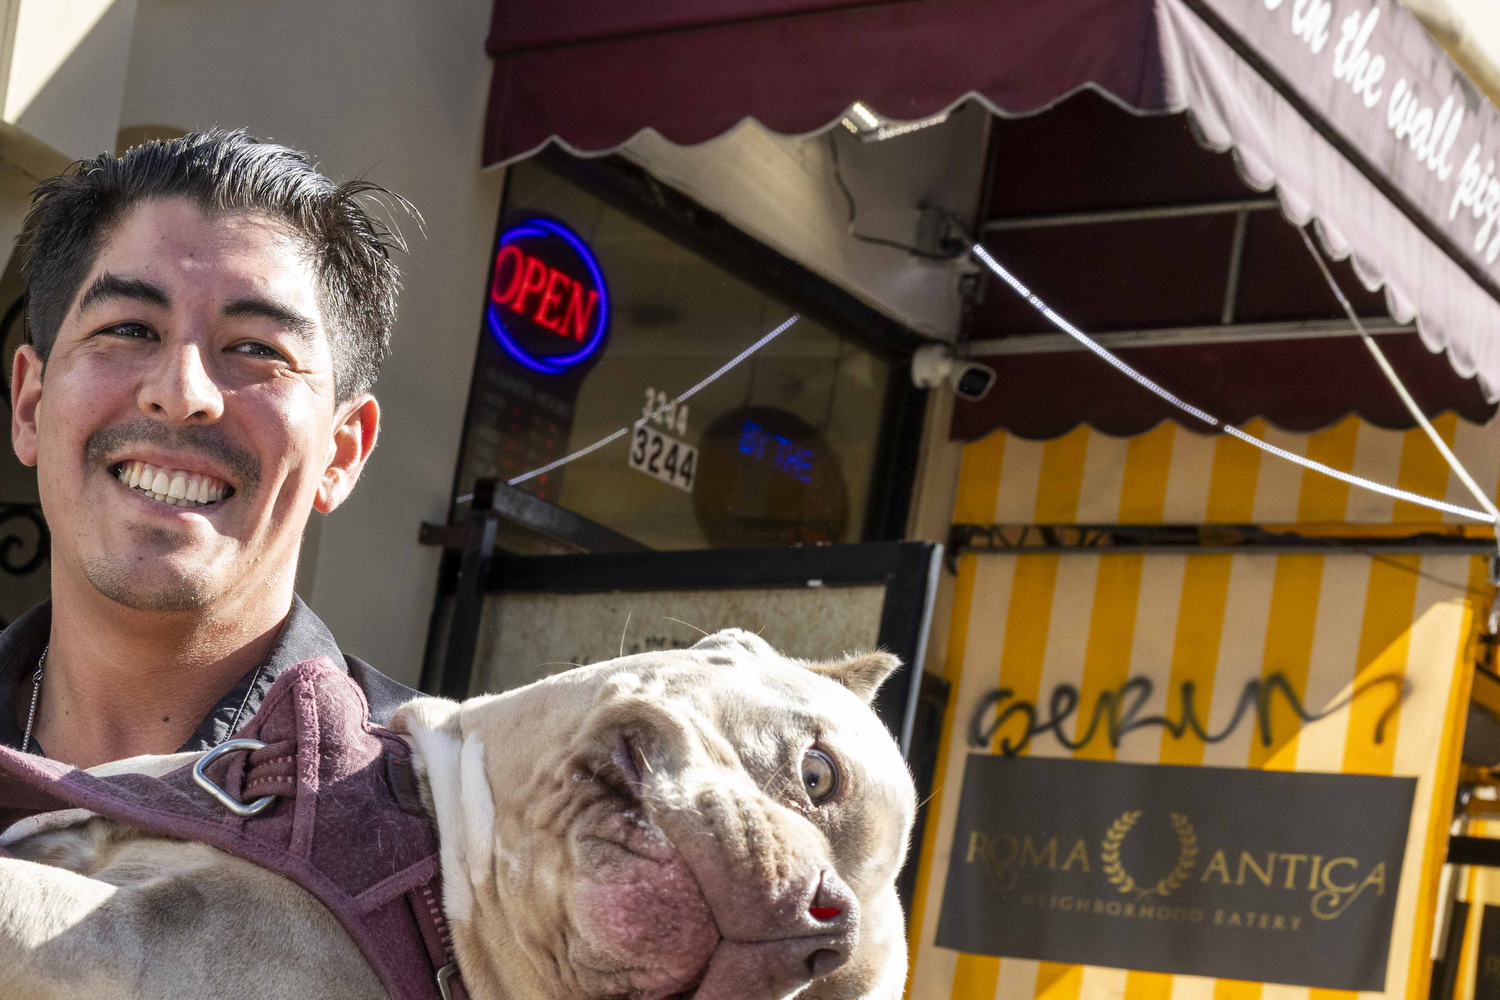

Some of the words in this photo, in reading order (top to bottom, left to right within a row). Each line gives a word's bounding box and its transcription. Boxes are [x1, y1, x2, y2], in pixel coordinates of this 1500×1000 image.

[1333, 7, 1385, 109] the
[1387, 78, 1463, 182] wall
[491, 246, 597, 342] OPEN
[642, 387, 690, 437] 3244
[633, 428, 695, 487] 3244
[966, 831, 1091, 890] ROMA
[1202, 849, 1386, 920] ANTICA
[1020, 893, 1202, 923] NEIGHBORHOOD
[1213, 908, 1304, 931] EATERY
